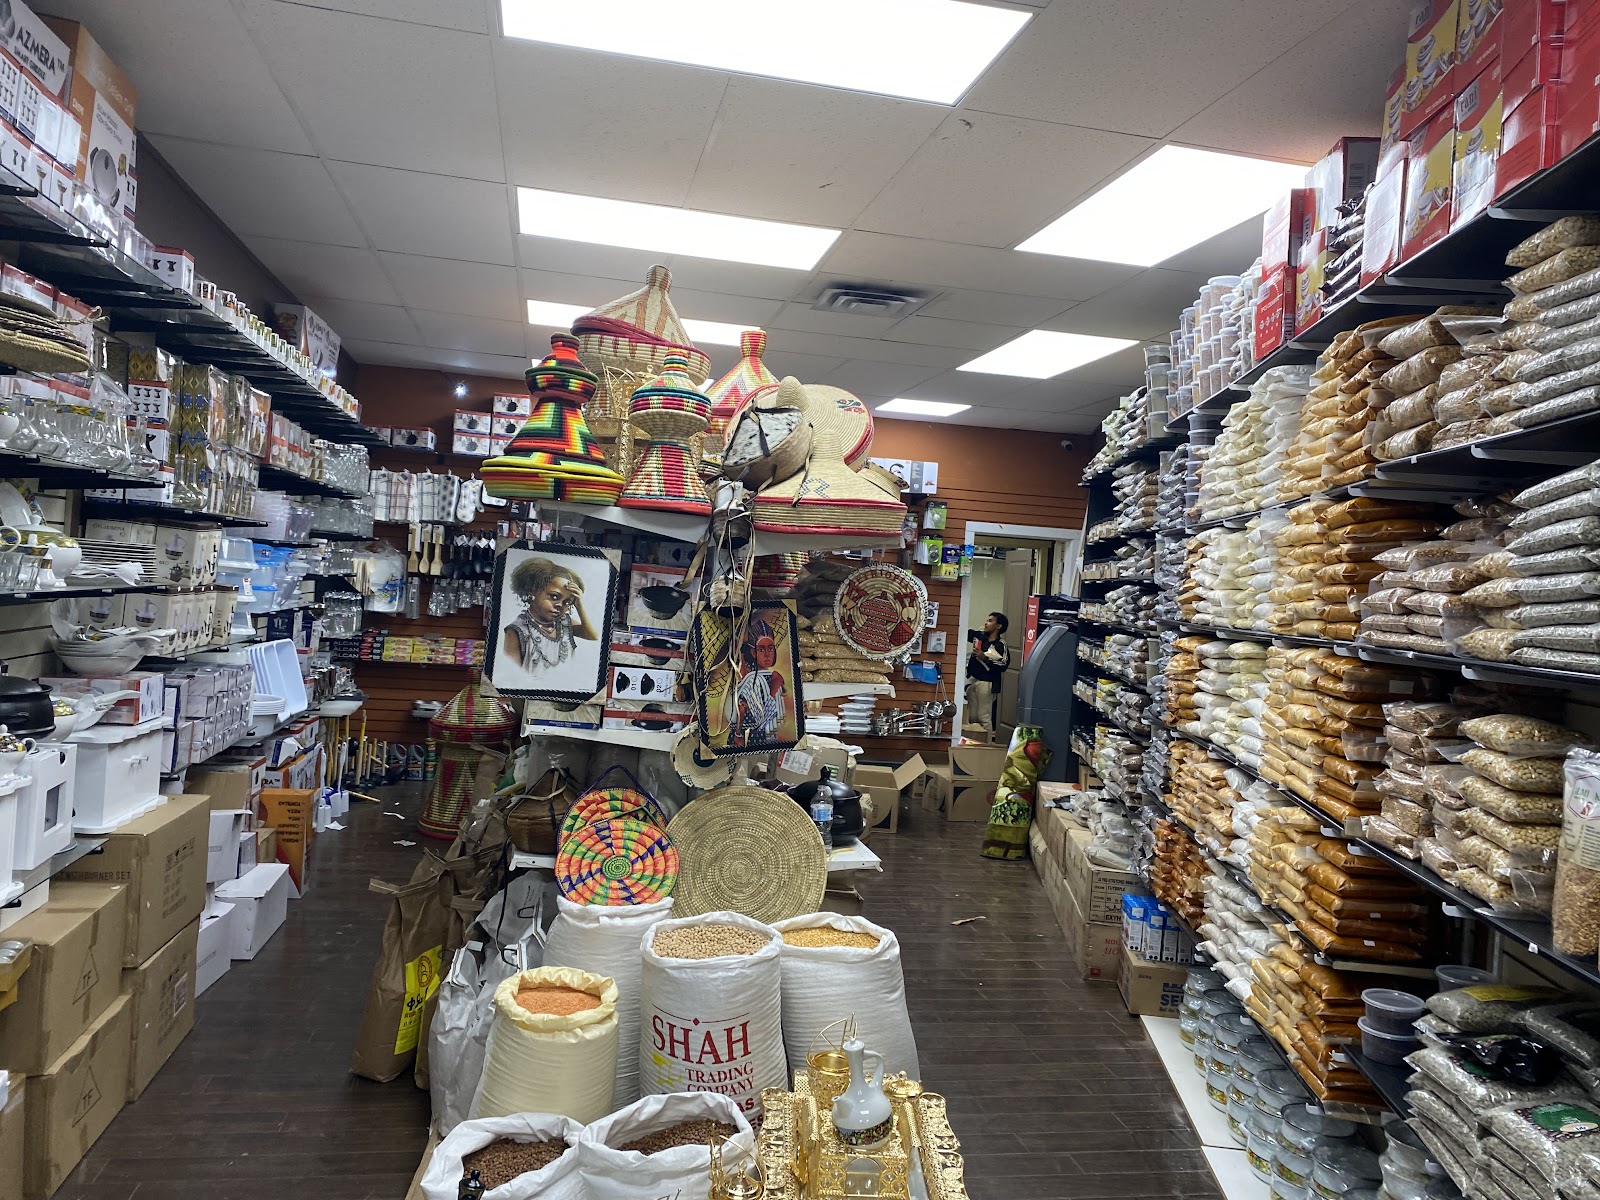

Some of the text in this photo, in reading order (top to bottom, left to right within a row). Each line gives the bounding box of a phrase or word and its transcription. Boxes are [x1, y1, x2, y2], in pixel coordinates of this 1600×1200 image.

[1461, 86, 1478, 113] rani
[84, 871, 114, 881] BURNER
[116, 871, 131, 880] SET
[82, 970, 92, 990] TF
[652, 1014, 752, 1065] SHAH
[685, 1061, 754, 1084] TRADING
[83, 1088, 93, 1109] TF
